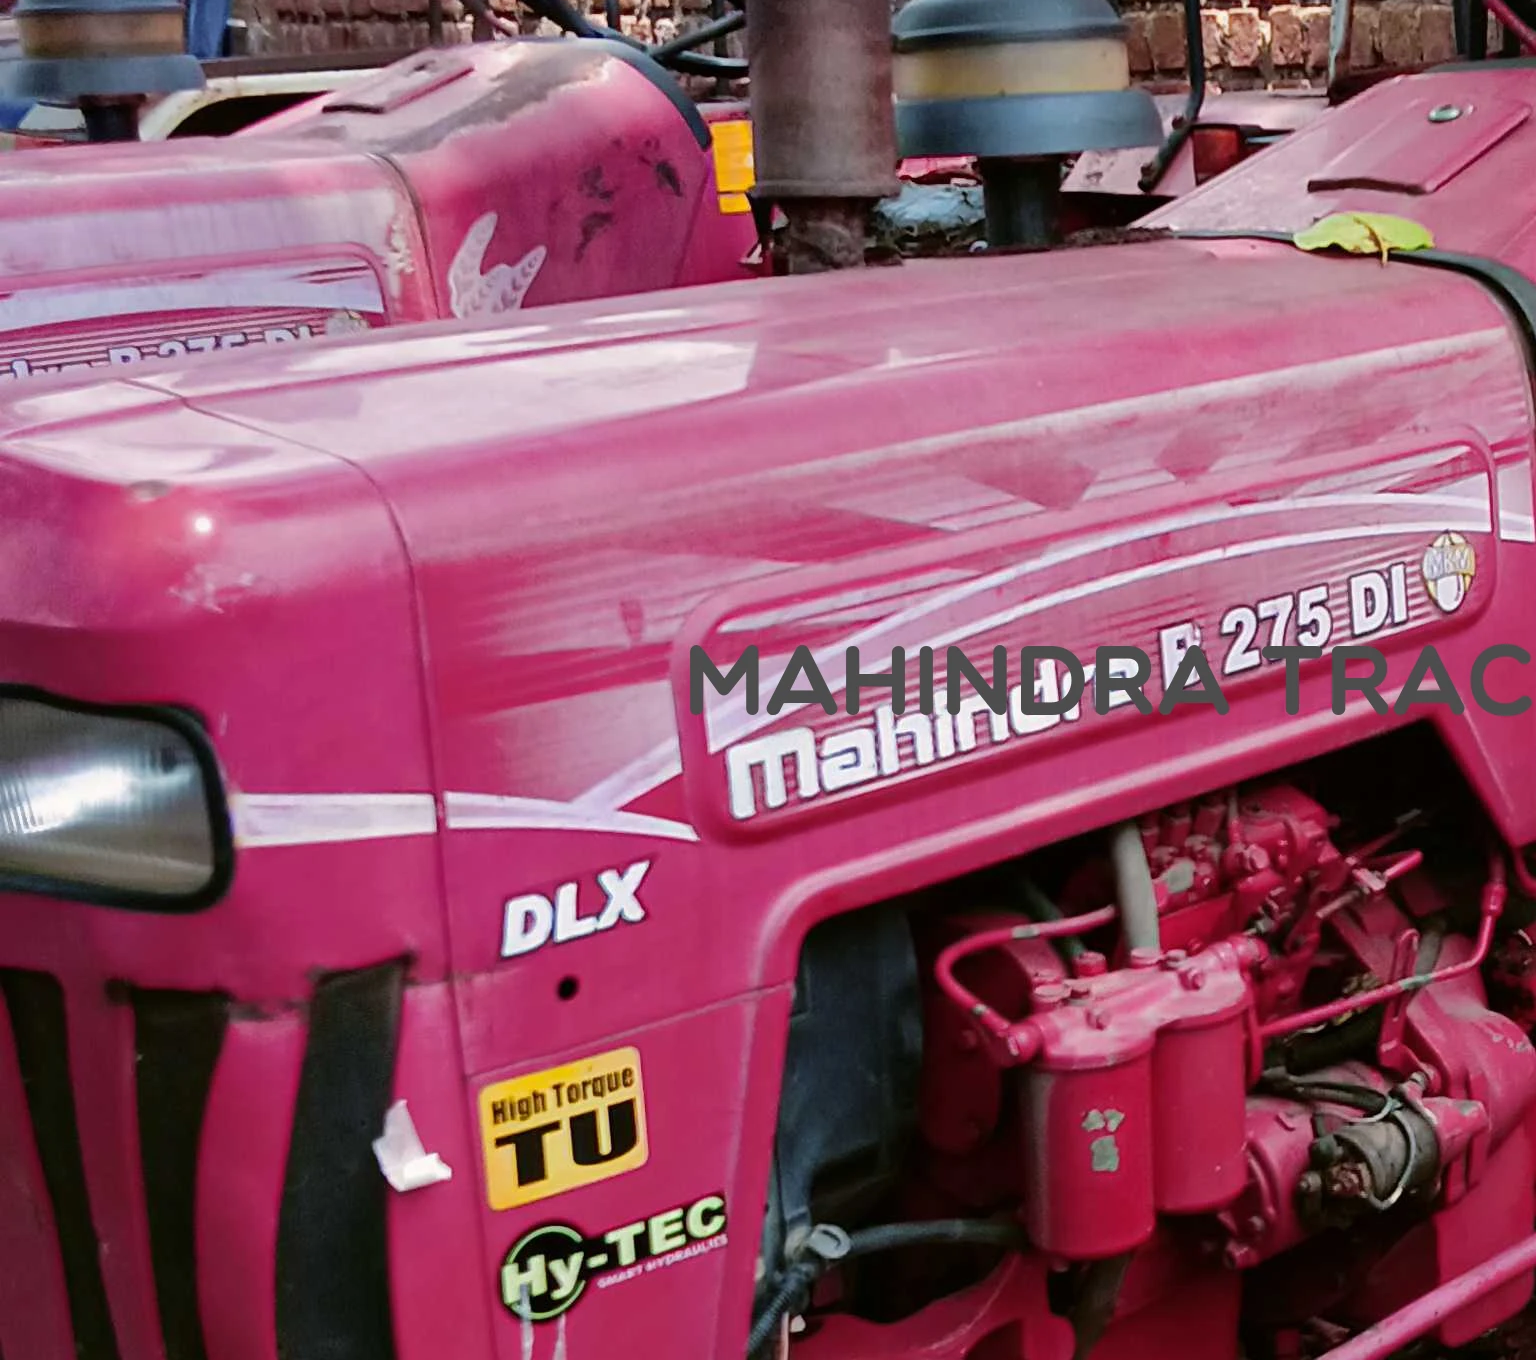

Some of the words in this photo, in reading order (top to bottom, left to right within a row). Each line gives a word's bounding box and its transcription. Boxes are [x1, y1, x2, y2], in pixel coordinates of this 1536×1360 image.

[1221, 584, 1335, 676] 275
[1350, 562, 1409, 637] DI
[500, 859, 651, 958] DLX
[491, 1089, 547, 1125] High
[551, 1067, 635, 1107] Torque
[495, 1098, 637, 1187] TU
[501, 1195, 726, 1305] Hy-TEC
